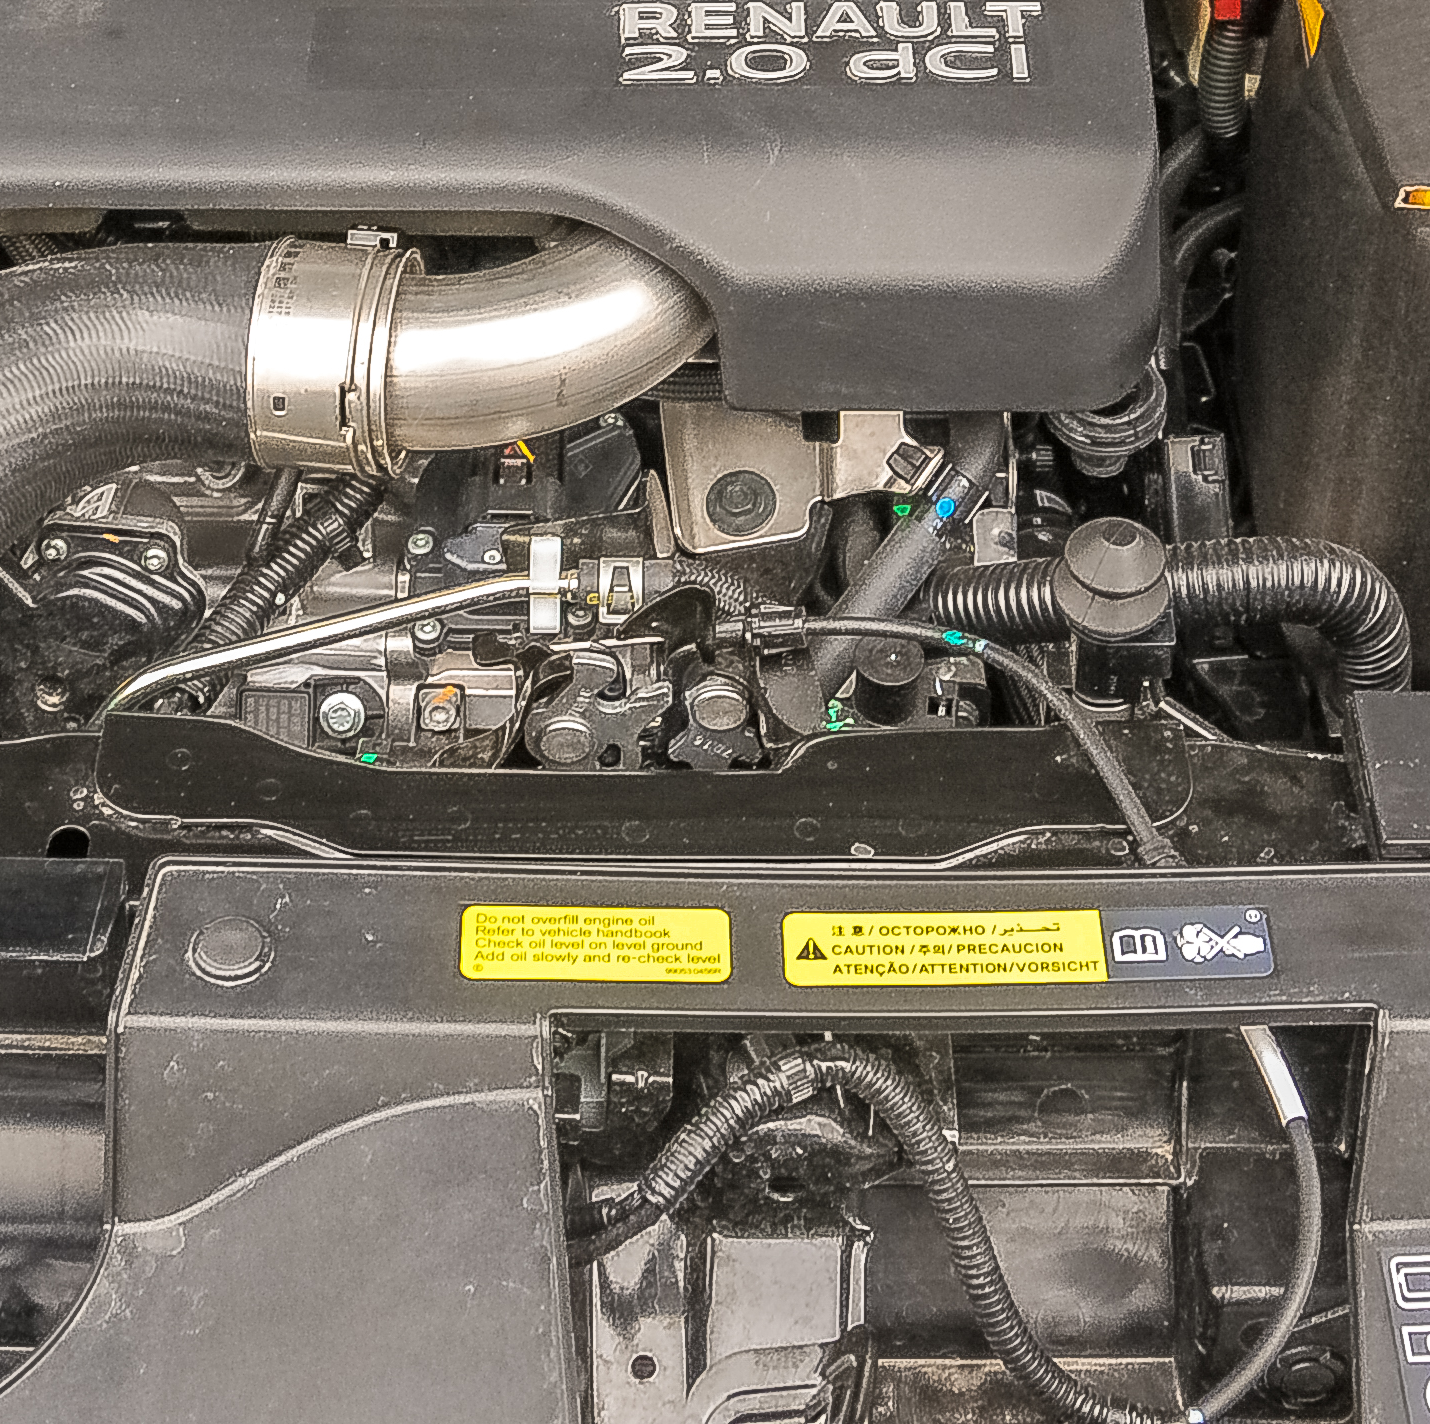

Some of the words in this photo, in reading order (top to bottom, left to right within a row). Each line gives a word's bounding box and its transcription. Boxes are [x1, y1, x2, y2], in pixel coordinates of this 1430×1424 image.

[619, 1, 1041, 40] RENAULT
[620, 43, 810, 83] 2.0
[475, 913, 499, 925] Do
[501, 914, 525, 925] not
[531, 914, 579, 926] overfill
[583, 916, 633, 929] engine
[638, 915, 655, 926] oil
[475, 926, 516, 937] Refer
[521, 927, 535, 937] to
[539, 927, 592, 938] vehicle
[597, 927, 671, 939] handbook
[475, 938, 524, 949] Check
[528, 938, 546, 949] oil
[550, 939, 585, 950] level
[589, 941, 608, 951] on
[612, 940, 646, 951] level
[651, 941, 703, 953] ground
[831, 944, 905, 956] CAUTION
[474, 950, 505, 962] Add
[510, 951, 527, 962] oil
[532, 952, 579, 965] slowly
[583, 953, 611, 964] and
[616, 953, 682, 965] re-check
[687, 954, 721, 965] level
